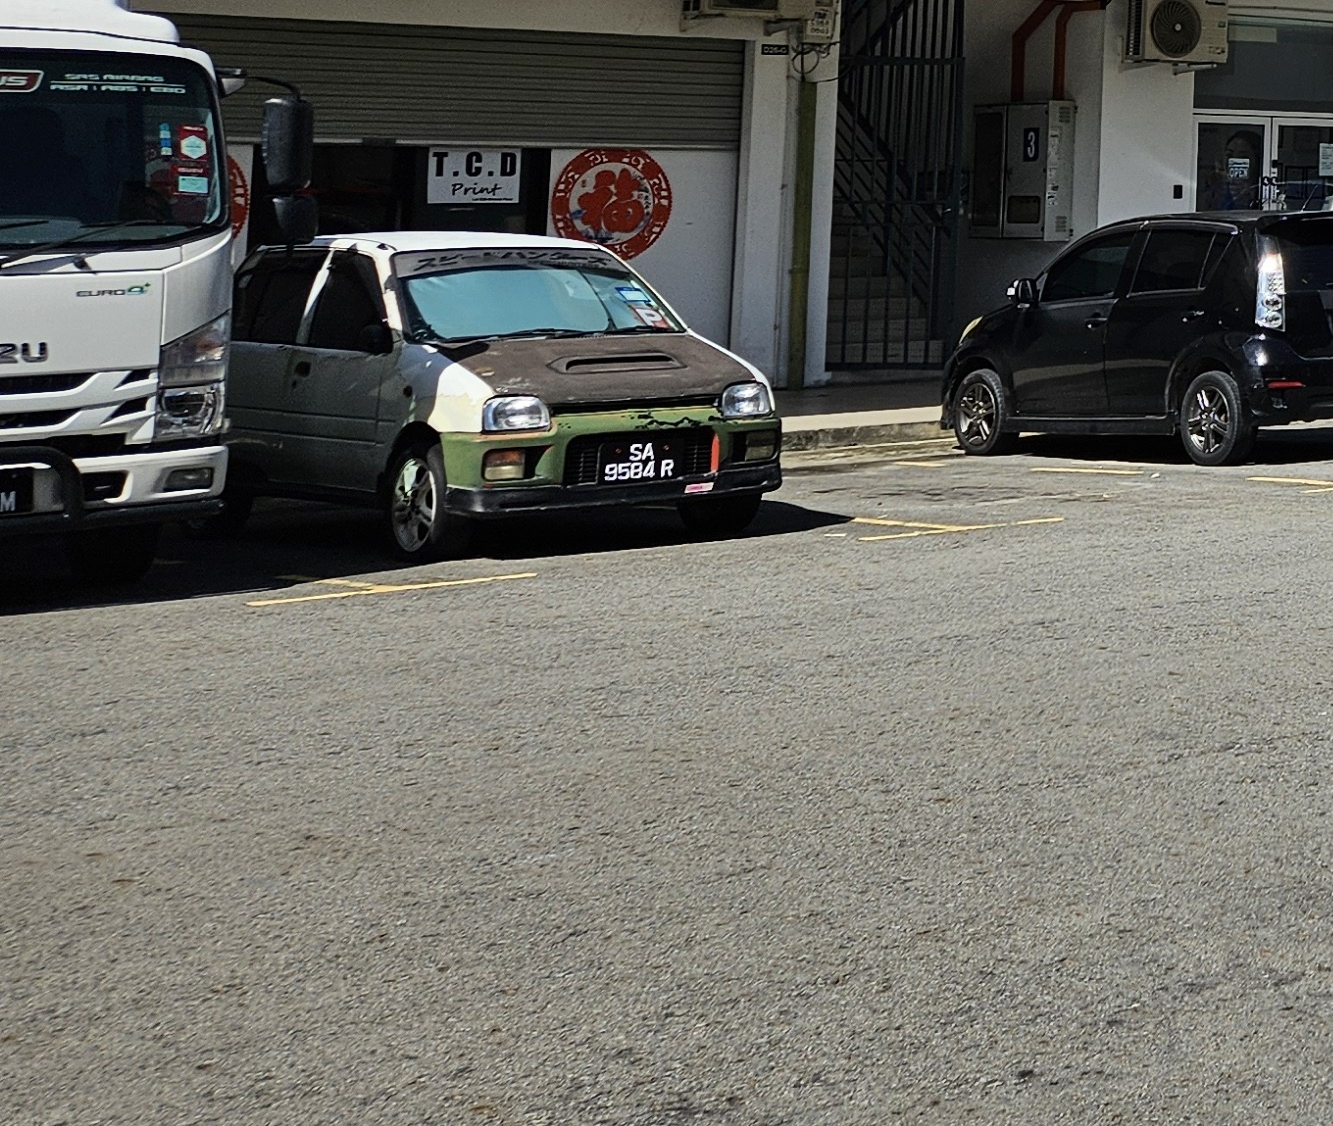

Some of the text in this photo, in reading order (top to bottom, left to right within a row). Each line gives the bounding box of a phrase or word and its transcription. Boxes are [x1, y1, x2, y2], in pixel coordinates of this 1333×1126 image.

[1027, 131, 1036, 159] 3
[431, 151, 517, 177] T.C.D
[450, 182, 503, 197] Print
[628, 442, 655, 461] SA
[604, 459, 675, 481] 9584 R
